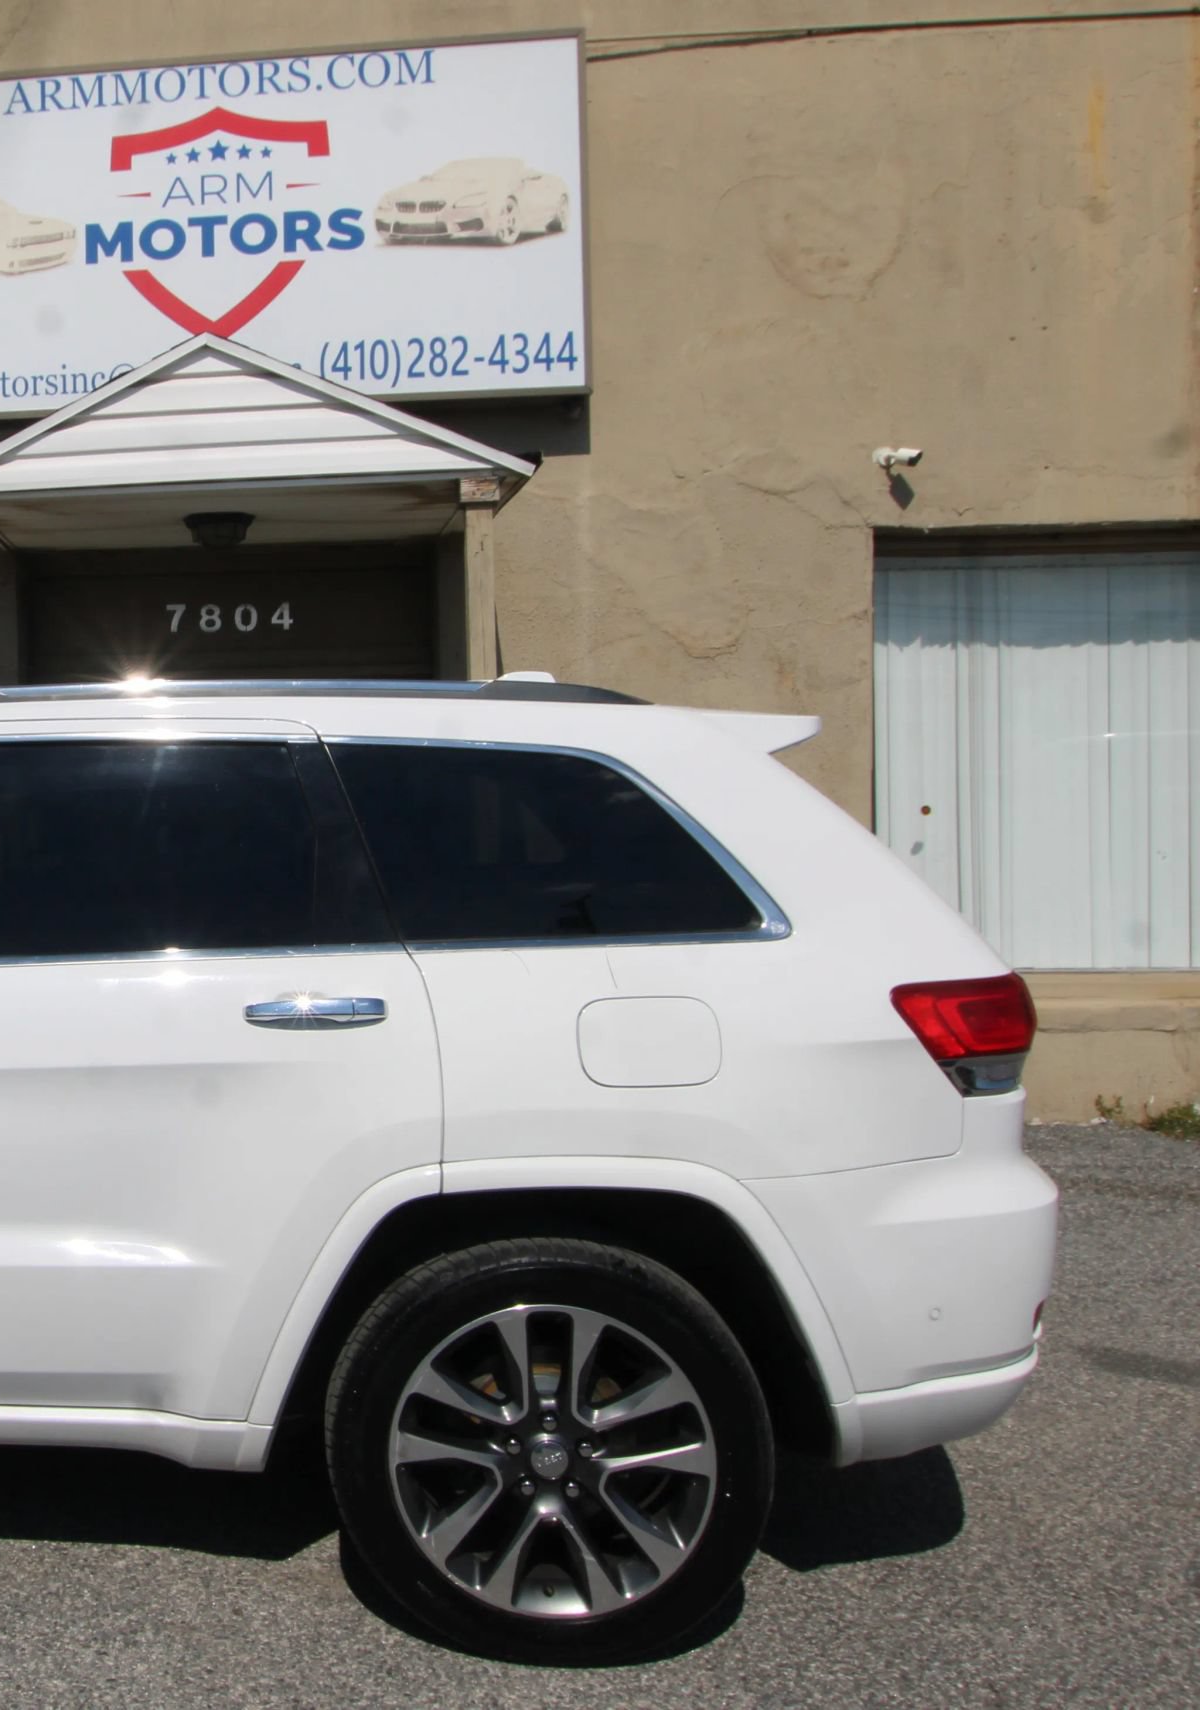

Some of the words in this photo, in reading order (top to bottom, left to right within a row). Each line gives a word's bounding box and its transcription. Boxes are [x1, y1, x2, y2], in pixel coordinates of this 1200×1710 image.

[3, 49, 436, 115] ARMMOTORS.COM
[161, 170, 274, 208] ARM
[84, 207, 366, 265] MOTORS
[319, 330, 579, 388] (410)282-4344
[166, 601, 294, 633] 7804
